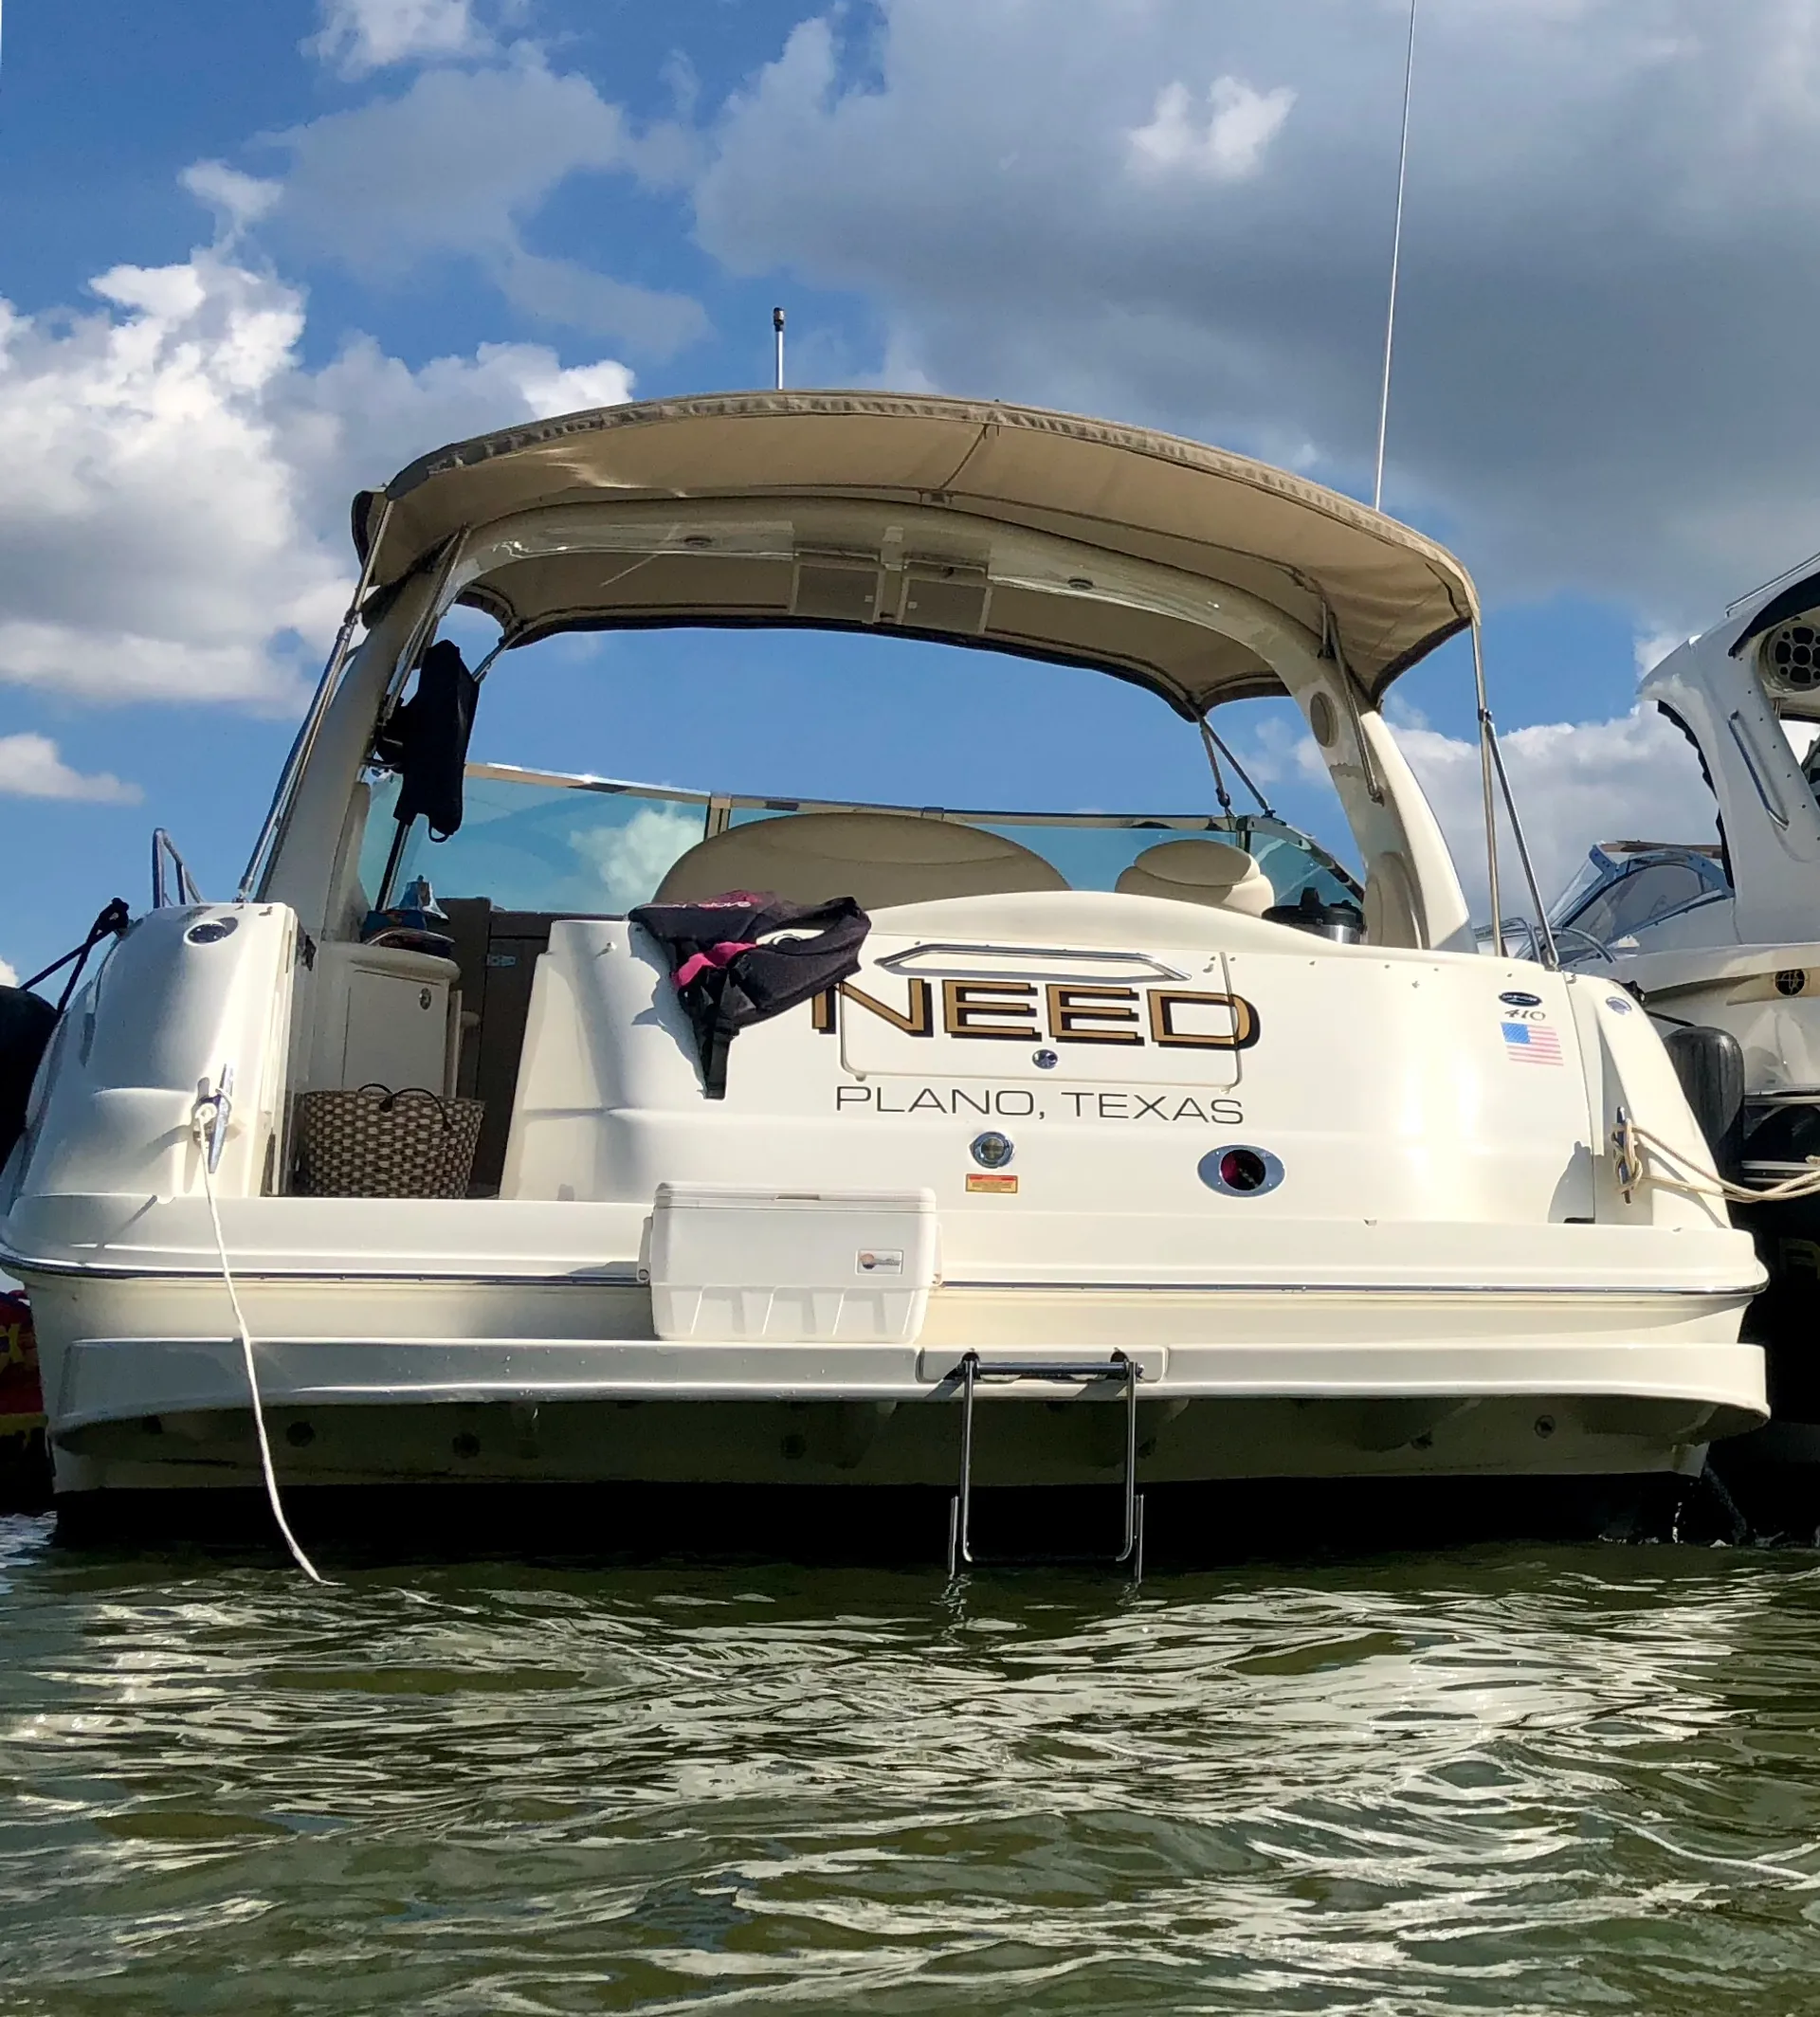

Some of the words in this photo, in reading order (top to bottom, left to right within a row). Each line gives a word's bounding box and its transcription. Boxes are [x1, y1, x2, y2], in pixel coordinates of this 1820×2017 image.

[812, 978, 1261, 1051] NEED
[1504, 1008, 1546, 1022] 410
[836, 1086, 1046, 1119] PLANO,
[1061, 1092, 1244, 1125] TEXAS
